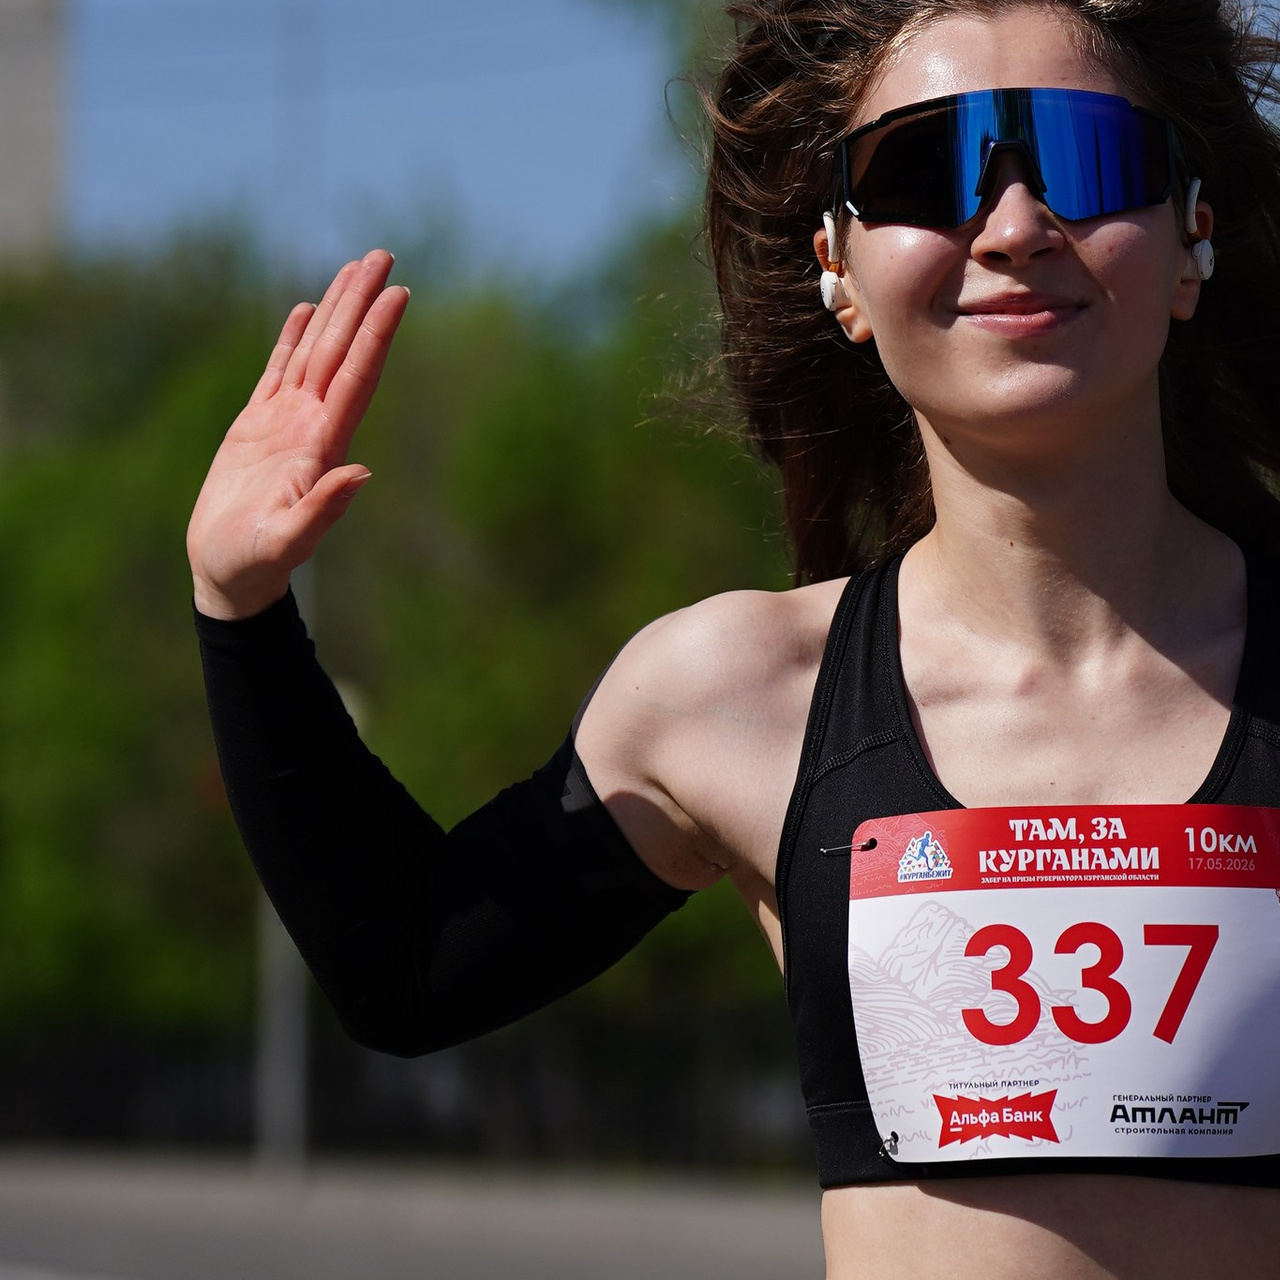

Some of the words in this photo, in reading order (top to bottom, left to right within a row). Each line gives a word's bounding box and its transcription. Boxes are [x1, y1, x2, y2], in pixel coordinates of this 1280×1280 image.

[1008, 817, 1085, 845] ТАМ,
[1091, 816, 1127, 840] ЗА
[978, 846, 1160, 873] КУРГАНАМИ
[1188, 857, 1256, 871] 17.05.2026
[981, 876, 1001, 884] ЗАБЕГ
[1012, 875, 1035, 883] ПРИЗЫ
[1036, 874, 1083, 882] ГУБЕРНАТОРА
[1084, 873, 1127, 881] КУРГАНСКОЙ
[1128, 873, 1159, 881] ОБЛАСТИ
[961, 921, 1220, 1047] 337
[949, 1080, 998, 1090] ТИТУЛЬНЫЙ
[1001, 1079, 1040, 1088] ПАРТНЕР
[1113, 1094, 1174, 1102] ГЕНЕРАЛЬНЫЙ
[1176, 1095, 1212, 1103] ПАРТНЕР
[950, 1109, 1000, 1131] Альфа
[1002, 1108, 1043, 1123] Банк
[1114, 1127, 1186, 1135] строительная
